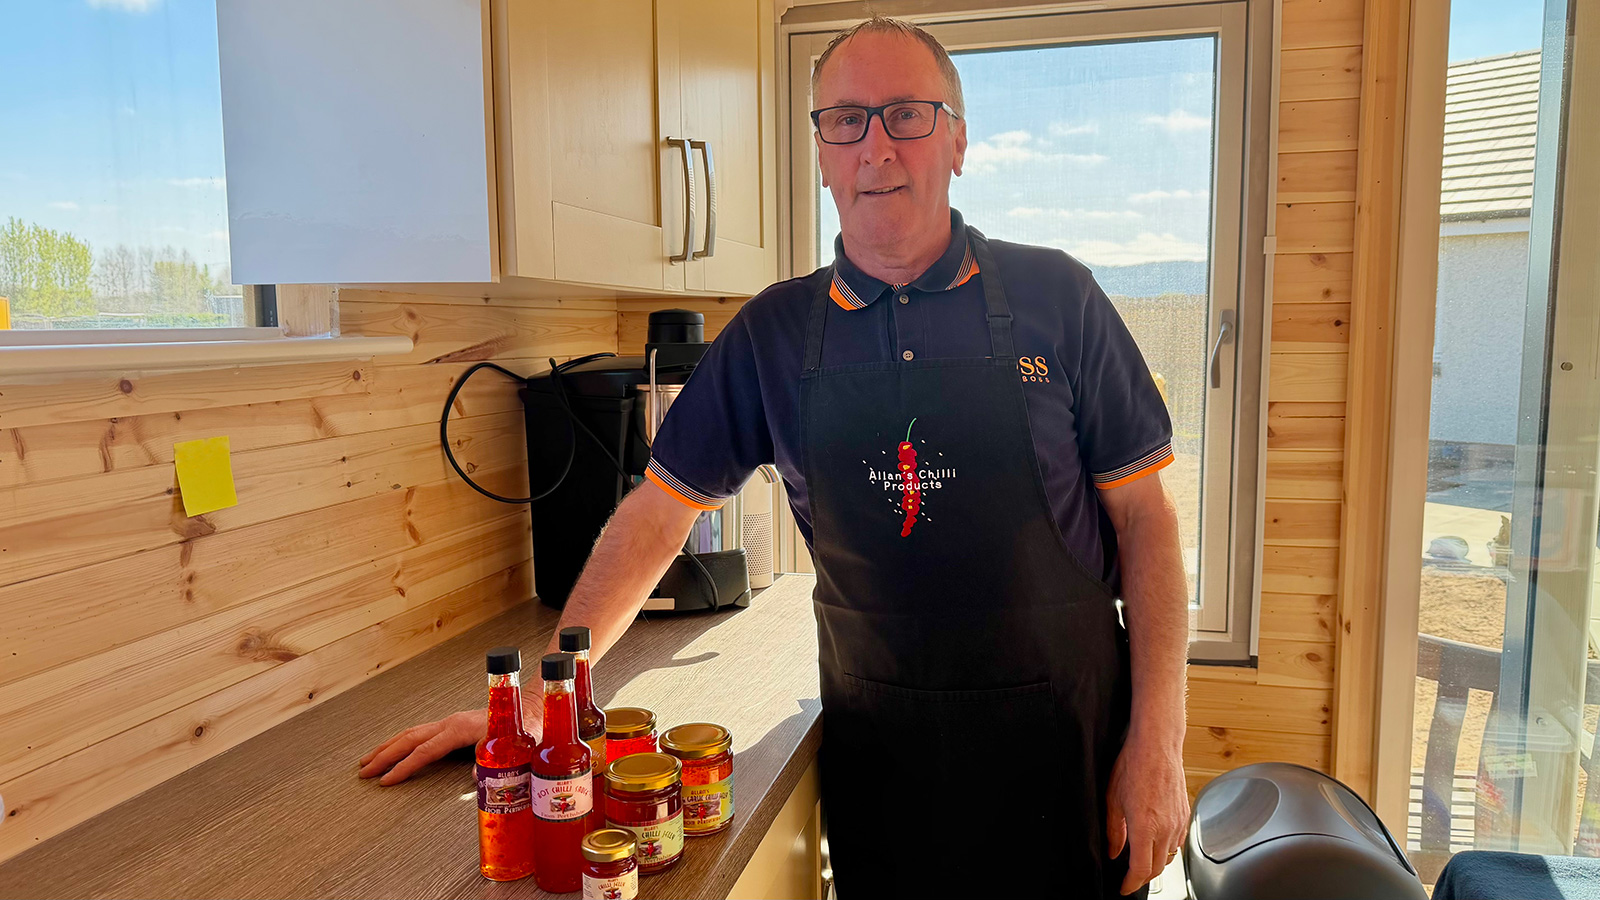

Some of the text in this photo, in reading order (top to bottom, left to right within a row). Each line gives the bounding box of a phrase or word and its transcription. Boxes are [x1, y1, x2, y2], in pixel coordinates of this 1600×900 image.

[869, 468, 956, 480] Allan's Chilli
[884, 480, 942, 491] Products
[551, 785, 573, 794] CHILLI
[641, 830, 661, 839] CHILLI
